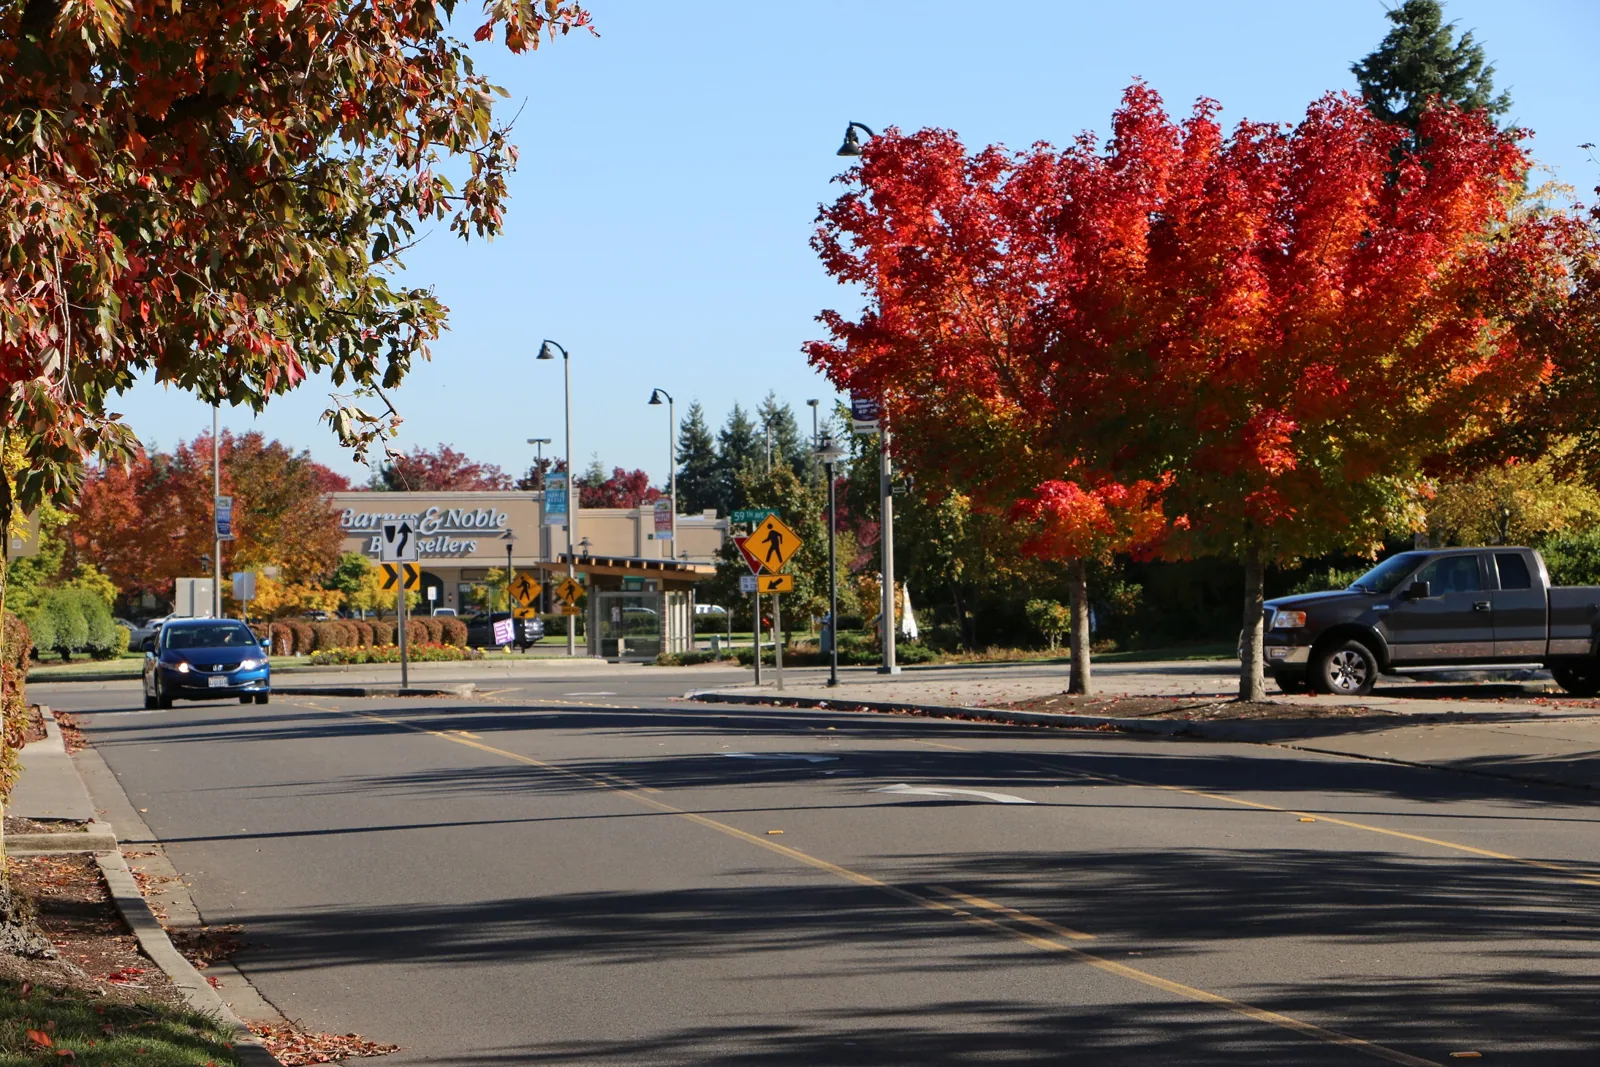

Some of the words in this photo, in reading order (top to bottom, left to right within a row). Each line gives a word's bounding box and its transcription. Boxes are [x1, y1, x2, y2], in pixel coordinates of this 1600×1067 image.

[420, 506, 443, 535] &
[444, 508, 508, 528] Noble
[734, 511, 745, 521] 59
[369, 536, 478, 553] Bsellers
